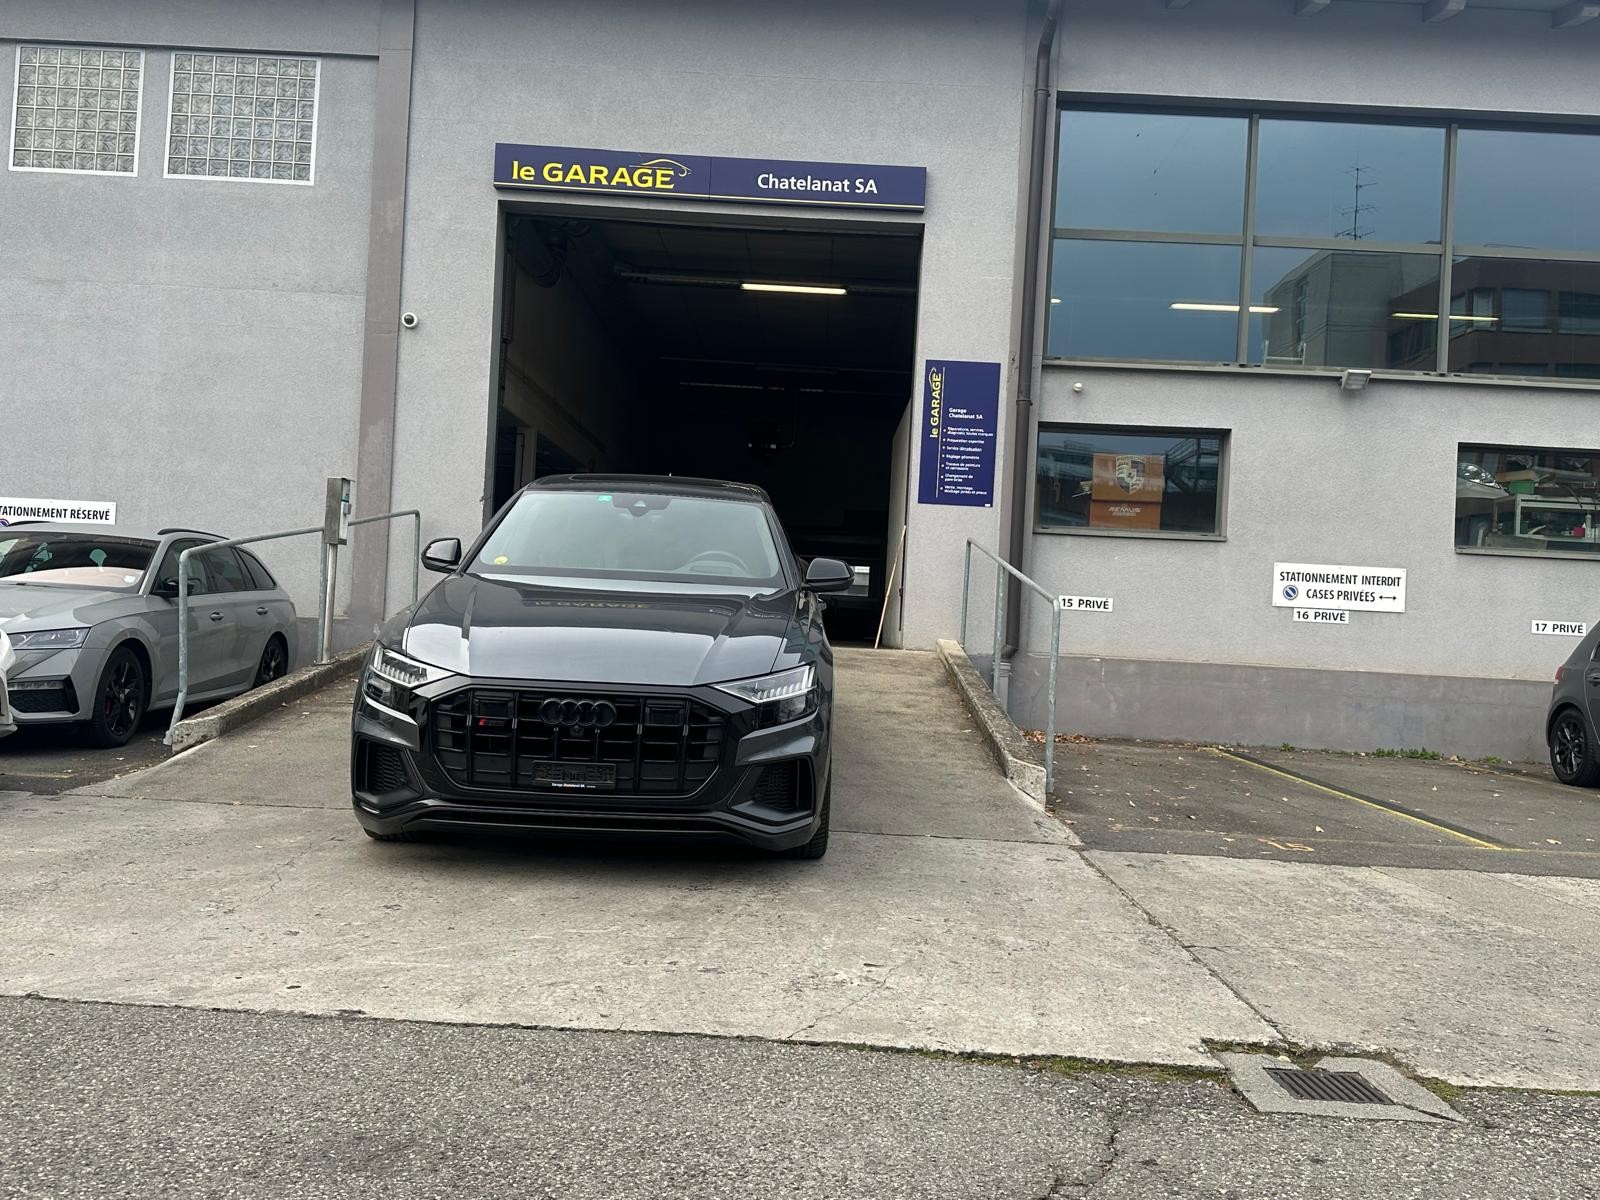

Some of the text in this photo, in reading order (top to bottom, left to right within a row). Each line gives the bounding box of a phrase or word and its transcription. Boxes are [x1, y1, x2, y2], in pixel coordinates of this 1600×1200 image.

[512, 160, 675, 189] le GARAGE
[757, 173, 878, 194] Chatelanat SA
[930, 373, 941, 438] le GARAGE
[0, 505, 110, 521] TATIONNEMENT RÉSERVÉ
[1280, 571, 1402, 587] STATIONNEMENT INTERDIT
[1306, 588, 1376, 602] CASES PRIVÉES
[1062, 598, 1110, 610] 15 PRIVÉ
[1296, 610, 1310, 620] 16
[1535, 623, 1548, 632] 17
